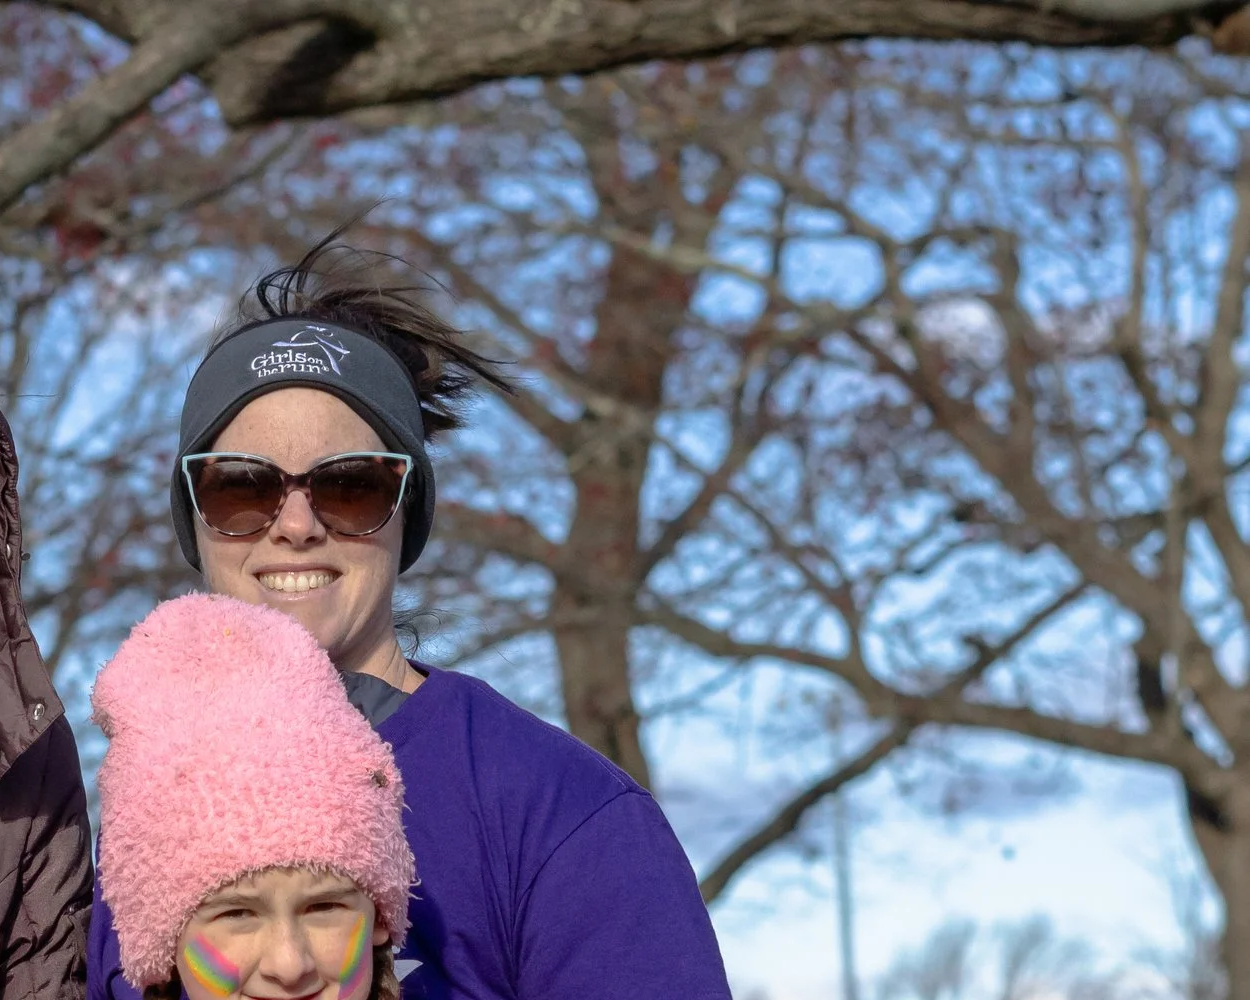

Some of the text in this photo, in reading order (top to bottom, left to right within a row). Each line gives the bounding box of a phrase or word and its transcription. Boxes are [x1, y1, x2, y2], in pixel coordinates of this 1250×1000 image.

[251, 350, 323, 371] Girls on
[257, 367, 279, 378] the
